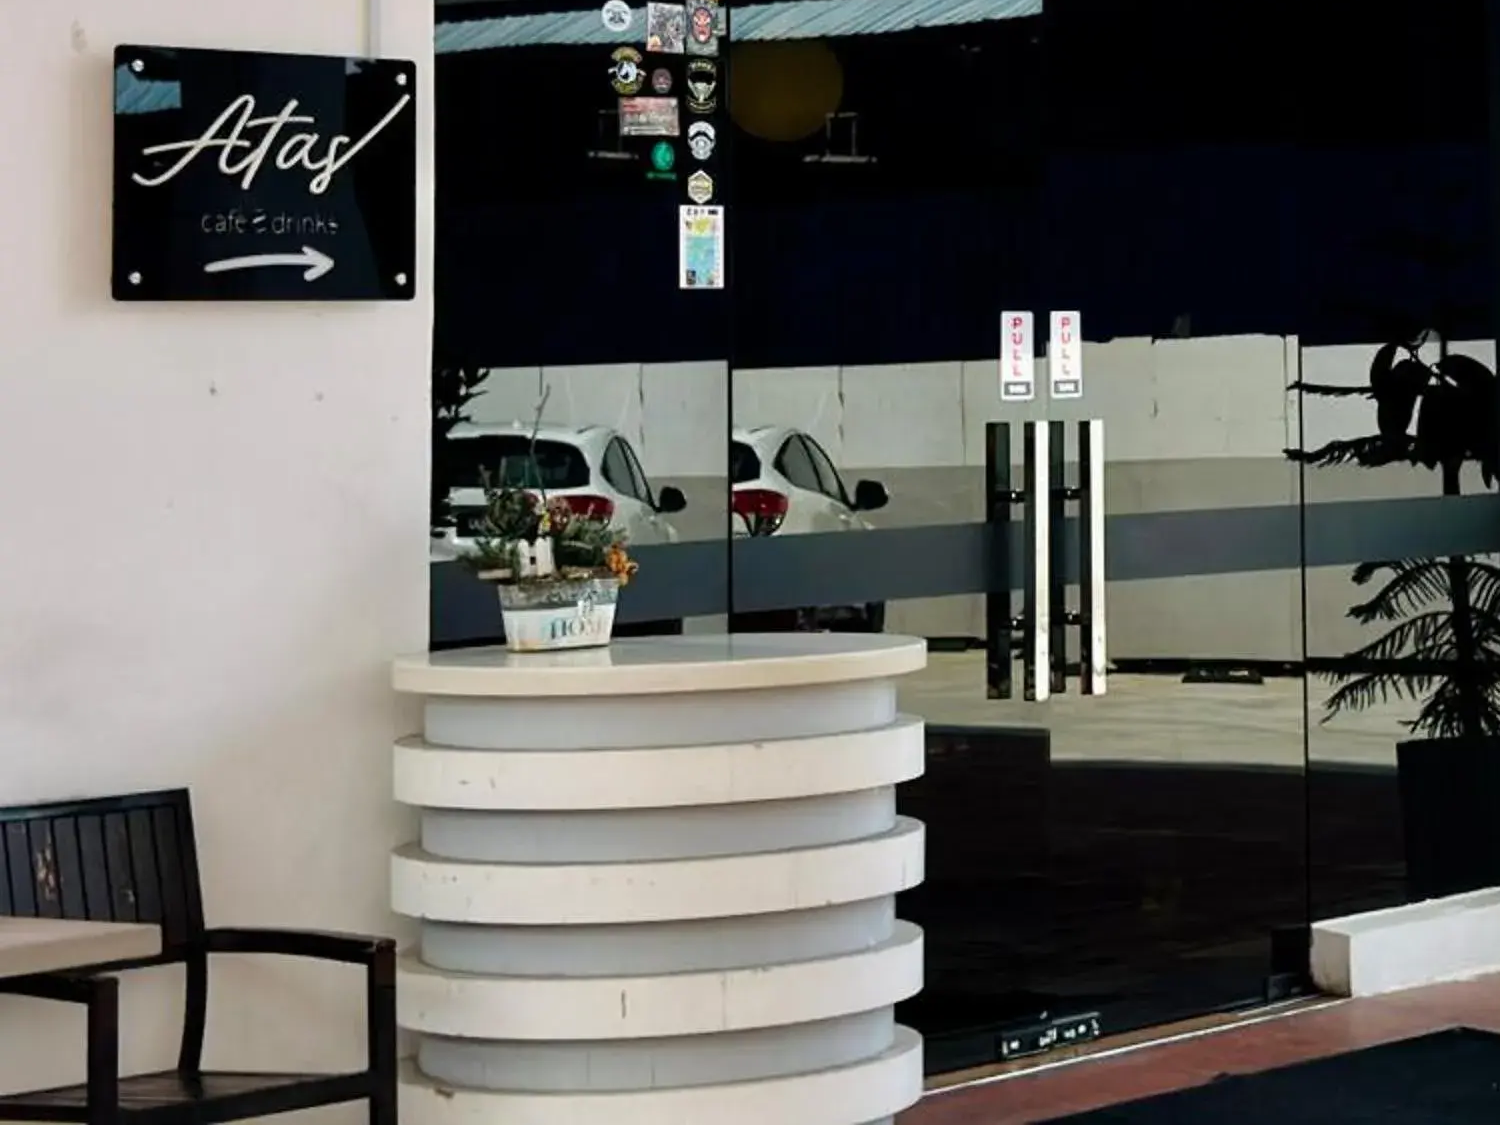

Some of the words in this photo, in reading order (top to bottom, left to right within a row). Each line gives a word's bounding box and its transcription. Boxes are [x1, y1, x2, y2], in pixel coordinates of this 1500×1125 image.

[131, 94, 410, 194] Atas
[1012, 317, 1022, 377] PULL
[1061, 317, 1071, 376] PULL
